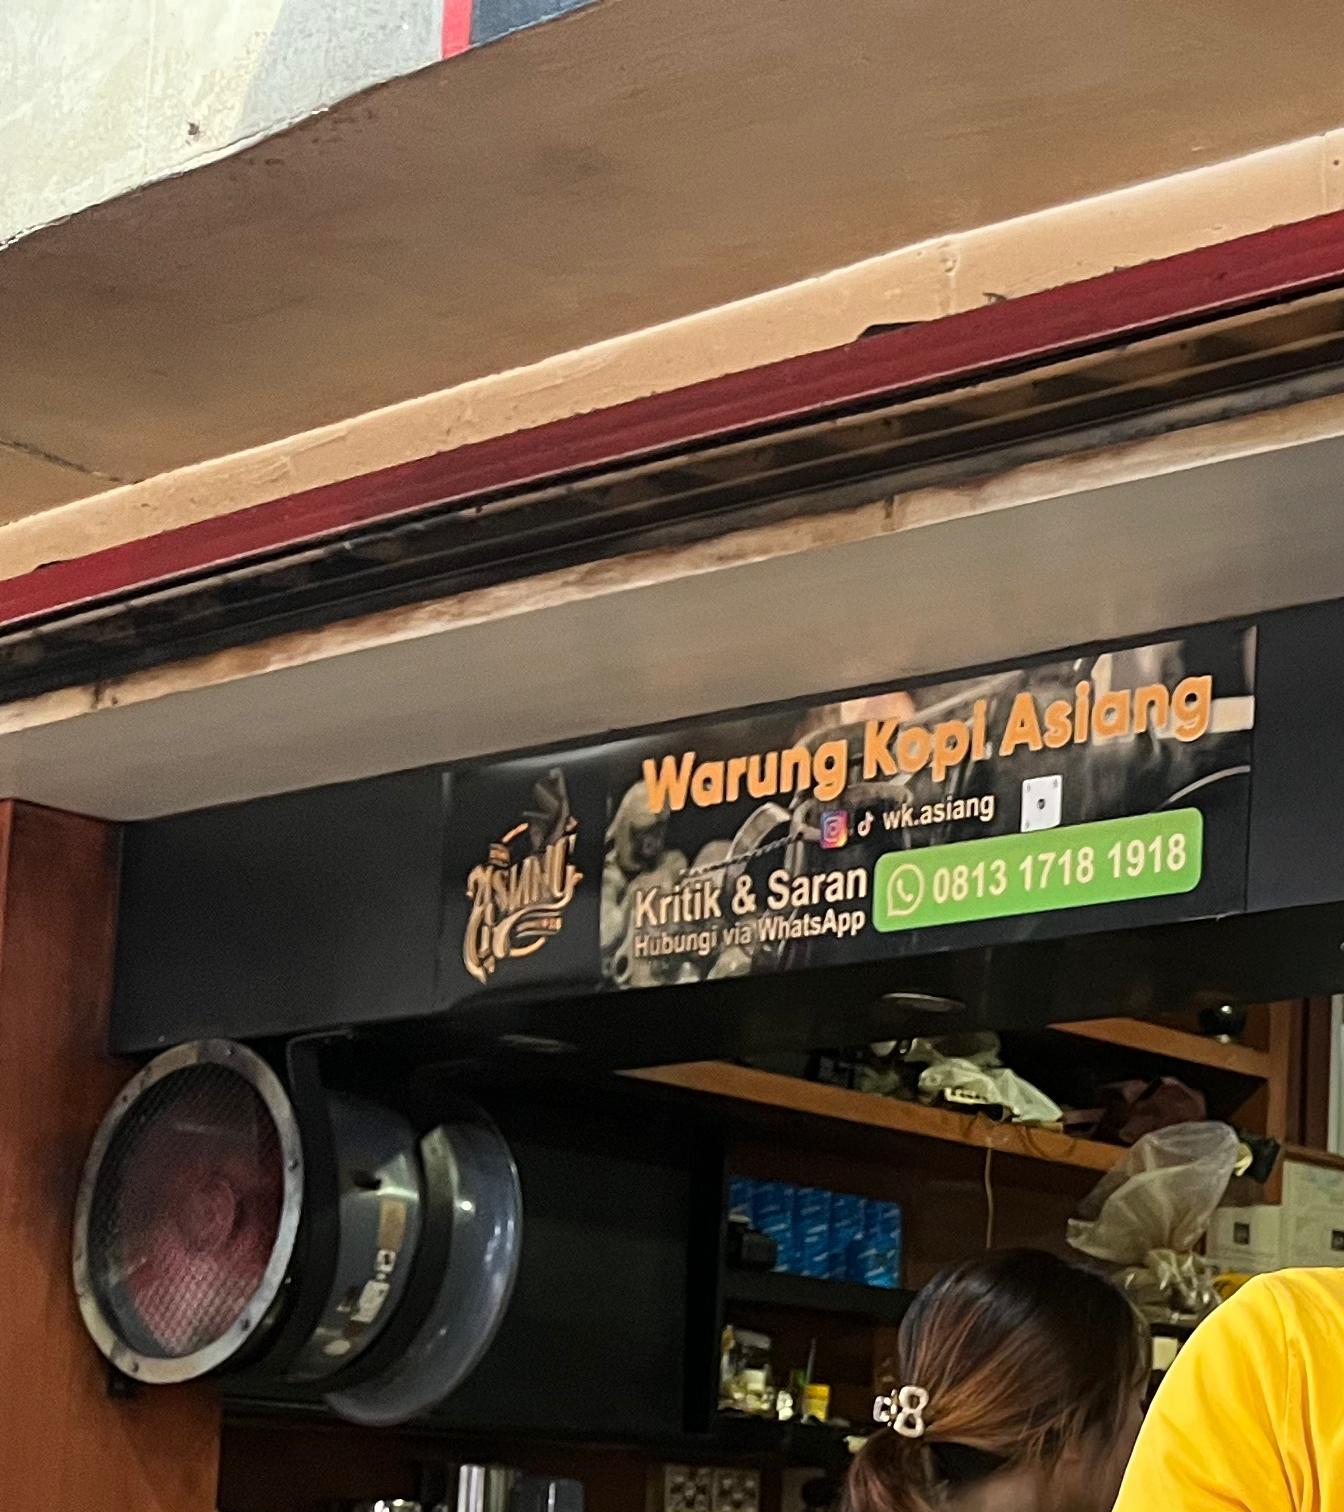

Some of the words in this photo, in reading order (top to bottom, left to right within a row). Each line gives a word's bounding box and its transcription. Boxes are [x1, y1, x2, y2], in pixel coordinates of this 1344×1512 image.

[642, 751, 848, 815] Warung
[862, 699, 988, 783] Kopi
[999, 674, 1213, 757] Asiang
[882, 794, 996, 831] wk.asiang
[634, 880, 723, 929] Kritik
[732, 873, 758, 915] &
[767, 866, 869, 911] Saran
[931, 857, 1009, 904] 0813
[1018, 845, 1095, 893] 1718
[1106, 832, 1188, 879] 1918
[633, 924, 718, 957] Hubungi
[722, 921, 752, 946] via
[758, 907, 866, 942] WhatsApp
